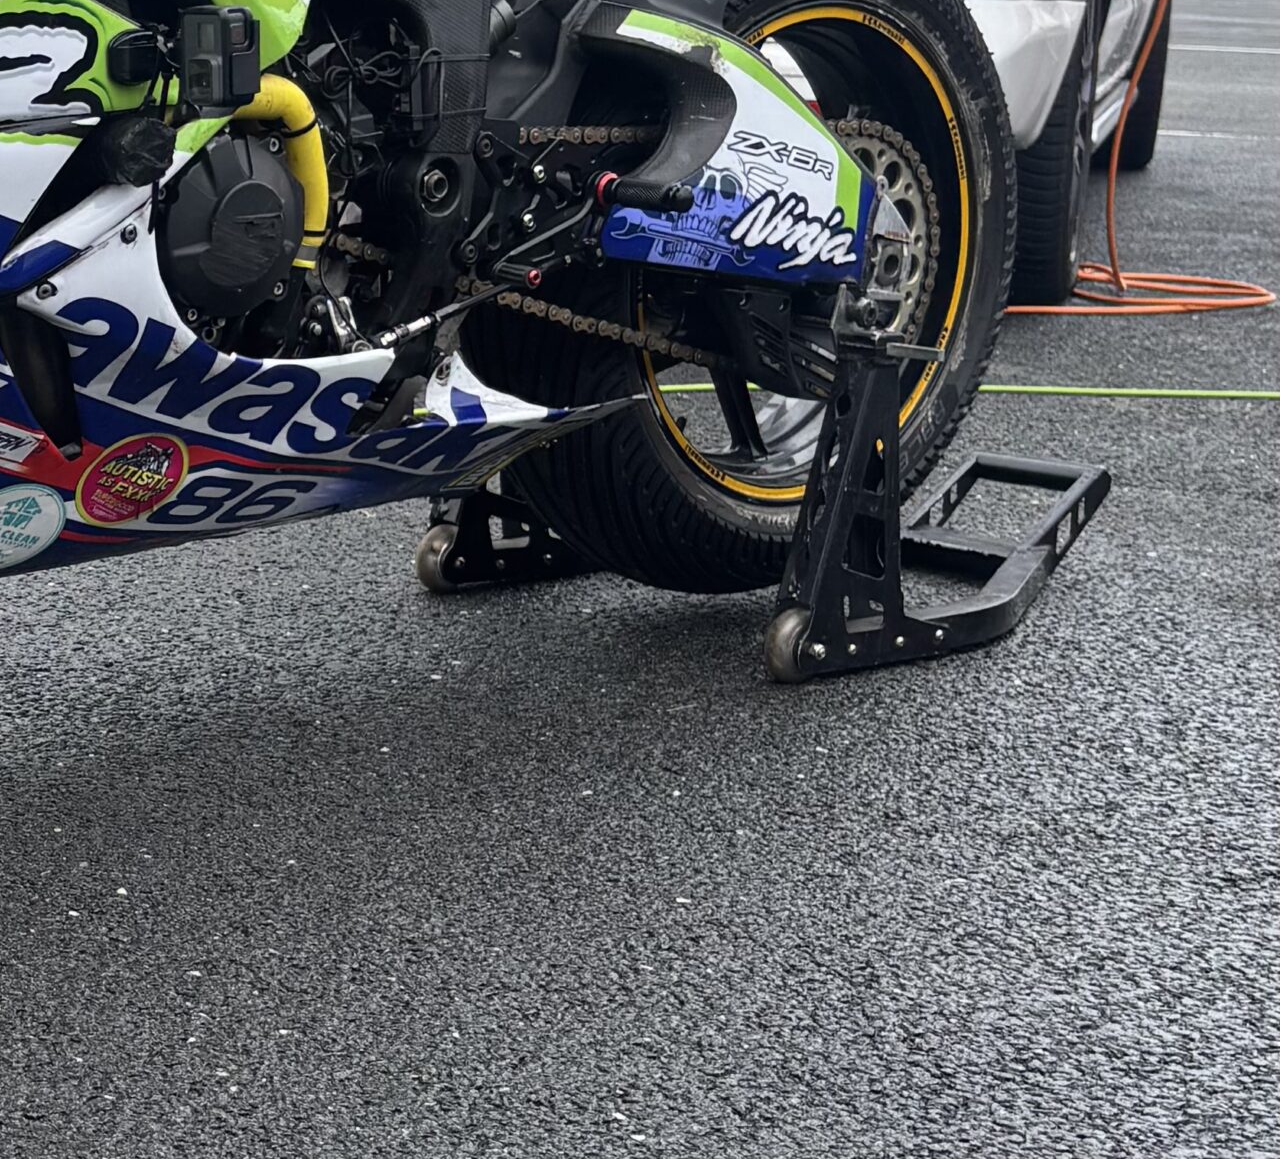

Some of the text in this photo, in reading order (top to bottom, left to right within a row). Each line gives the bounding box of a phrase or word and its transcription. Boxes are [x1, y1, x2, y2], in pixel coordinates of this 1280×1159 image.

[728, 130, 834, 182] ZX-6R
[729, 192, 857, 271] Ninja
[97, 476, 114, 487] AS
[100, 460, 174, 490] AUTISTIC
[147, 476, 318, 525] 86
[1, 529, 40, 545] CLEAN
